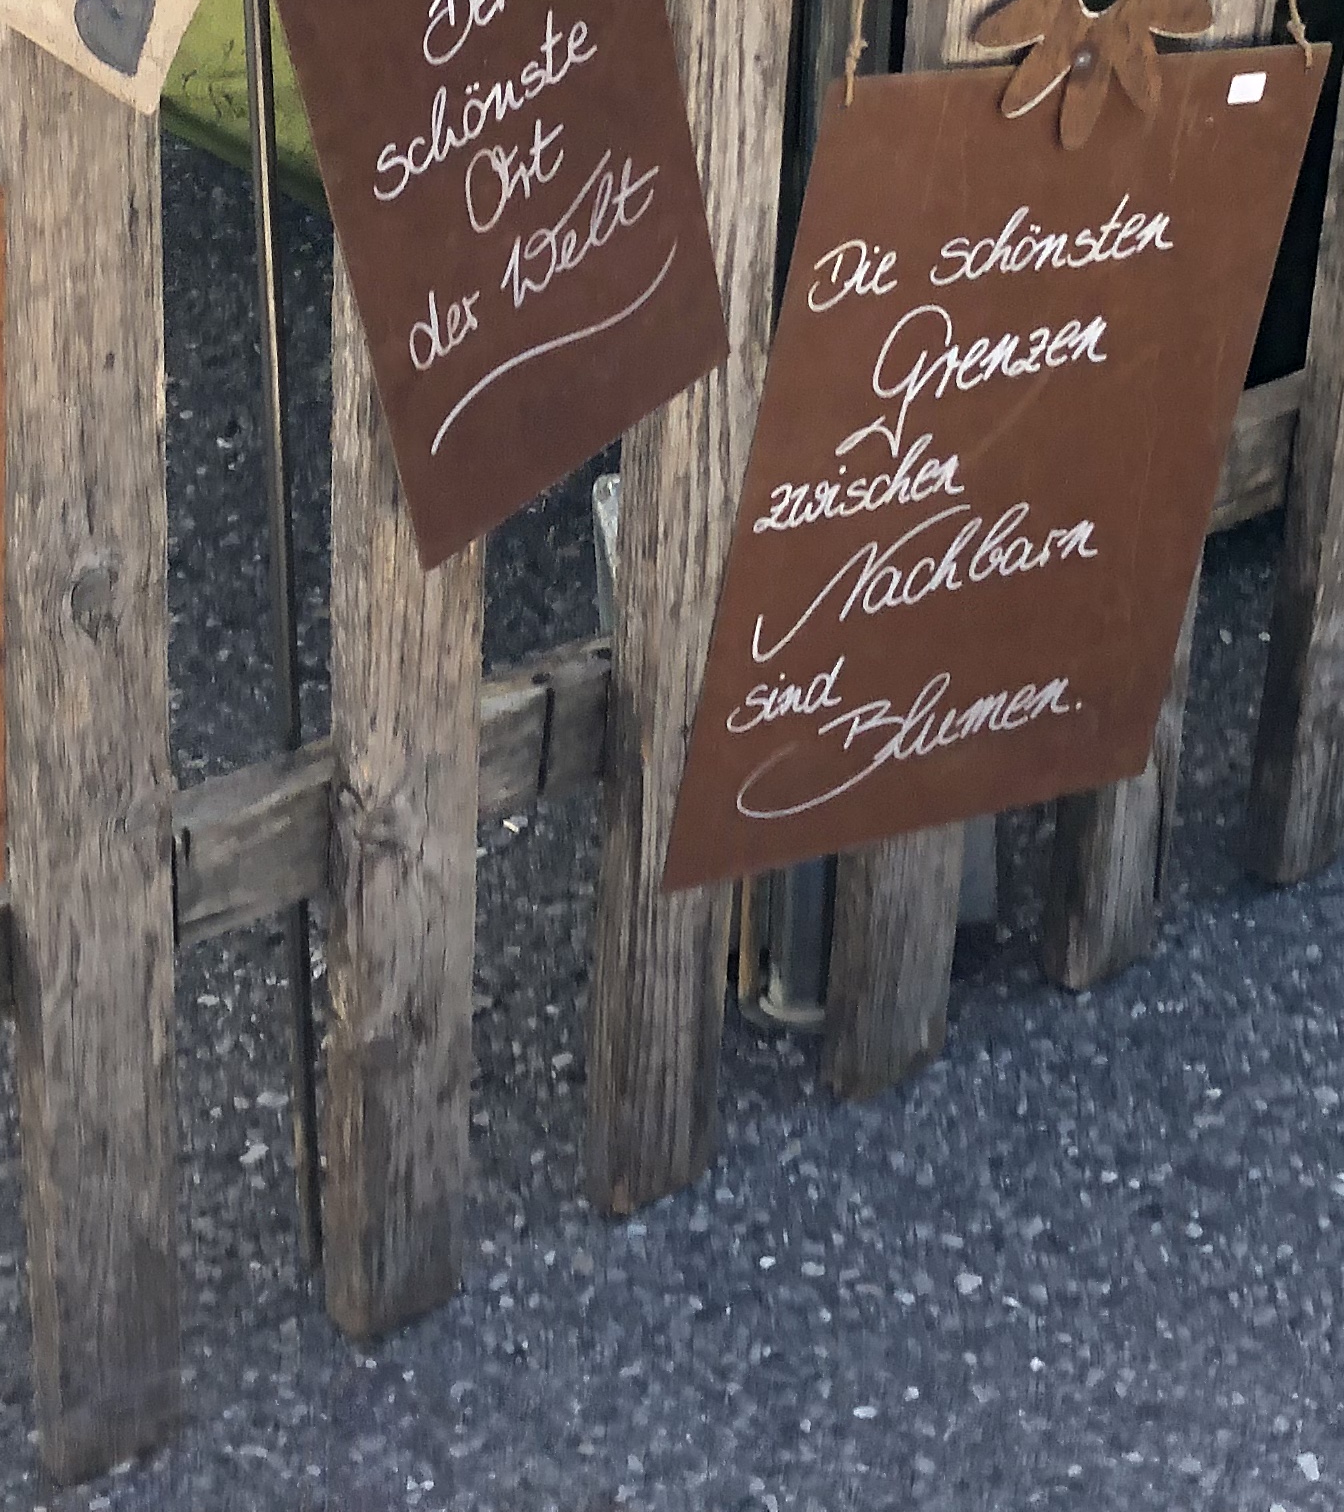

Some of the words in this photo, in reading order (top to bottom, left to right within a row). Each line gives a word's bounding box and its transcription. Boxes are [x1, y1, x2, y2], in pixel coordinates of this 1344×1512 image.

[373, 18, 598, 202] schönste
[464, 122, 566, 235] Ort
[408, 290, 481, 372] der
[501, 148, 659, 309] Welt
[806, 238, 898, 314] Die
[929, 193, 1174, 288] schönsten
[835, 304, 1108, 456] Grenzen
[751, 432, 965, 534] zwischen
[753, 501, 1097, 663] Nachbarn
[727, 656, 844, 735] sind
[736, 673, 1083, 819] Blumen.
